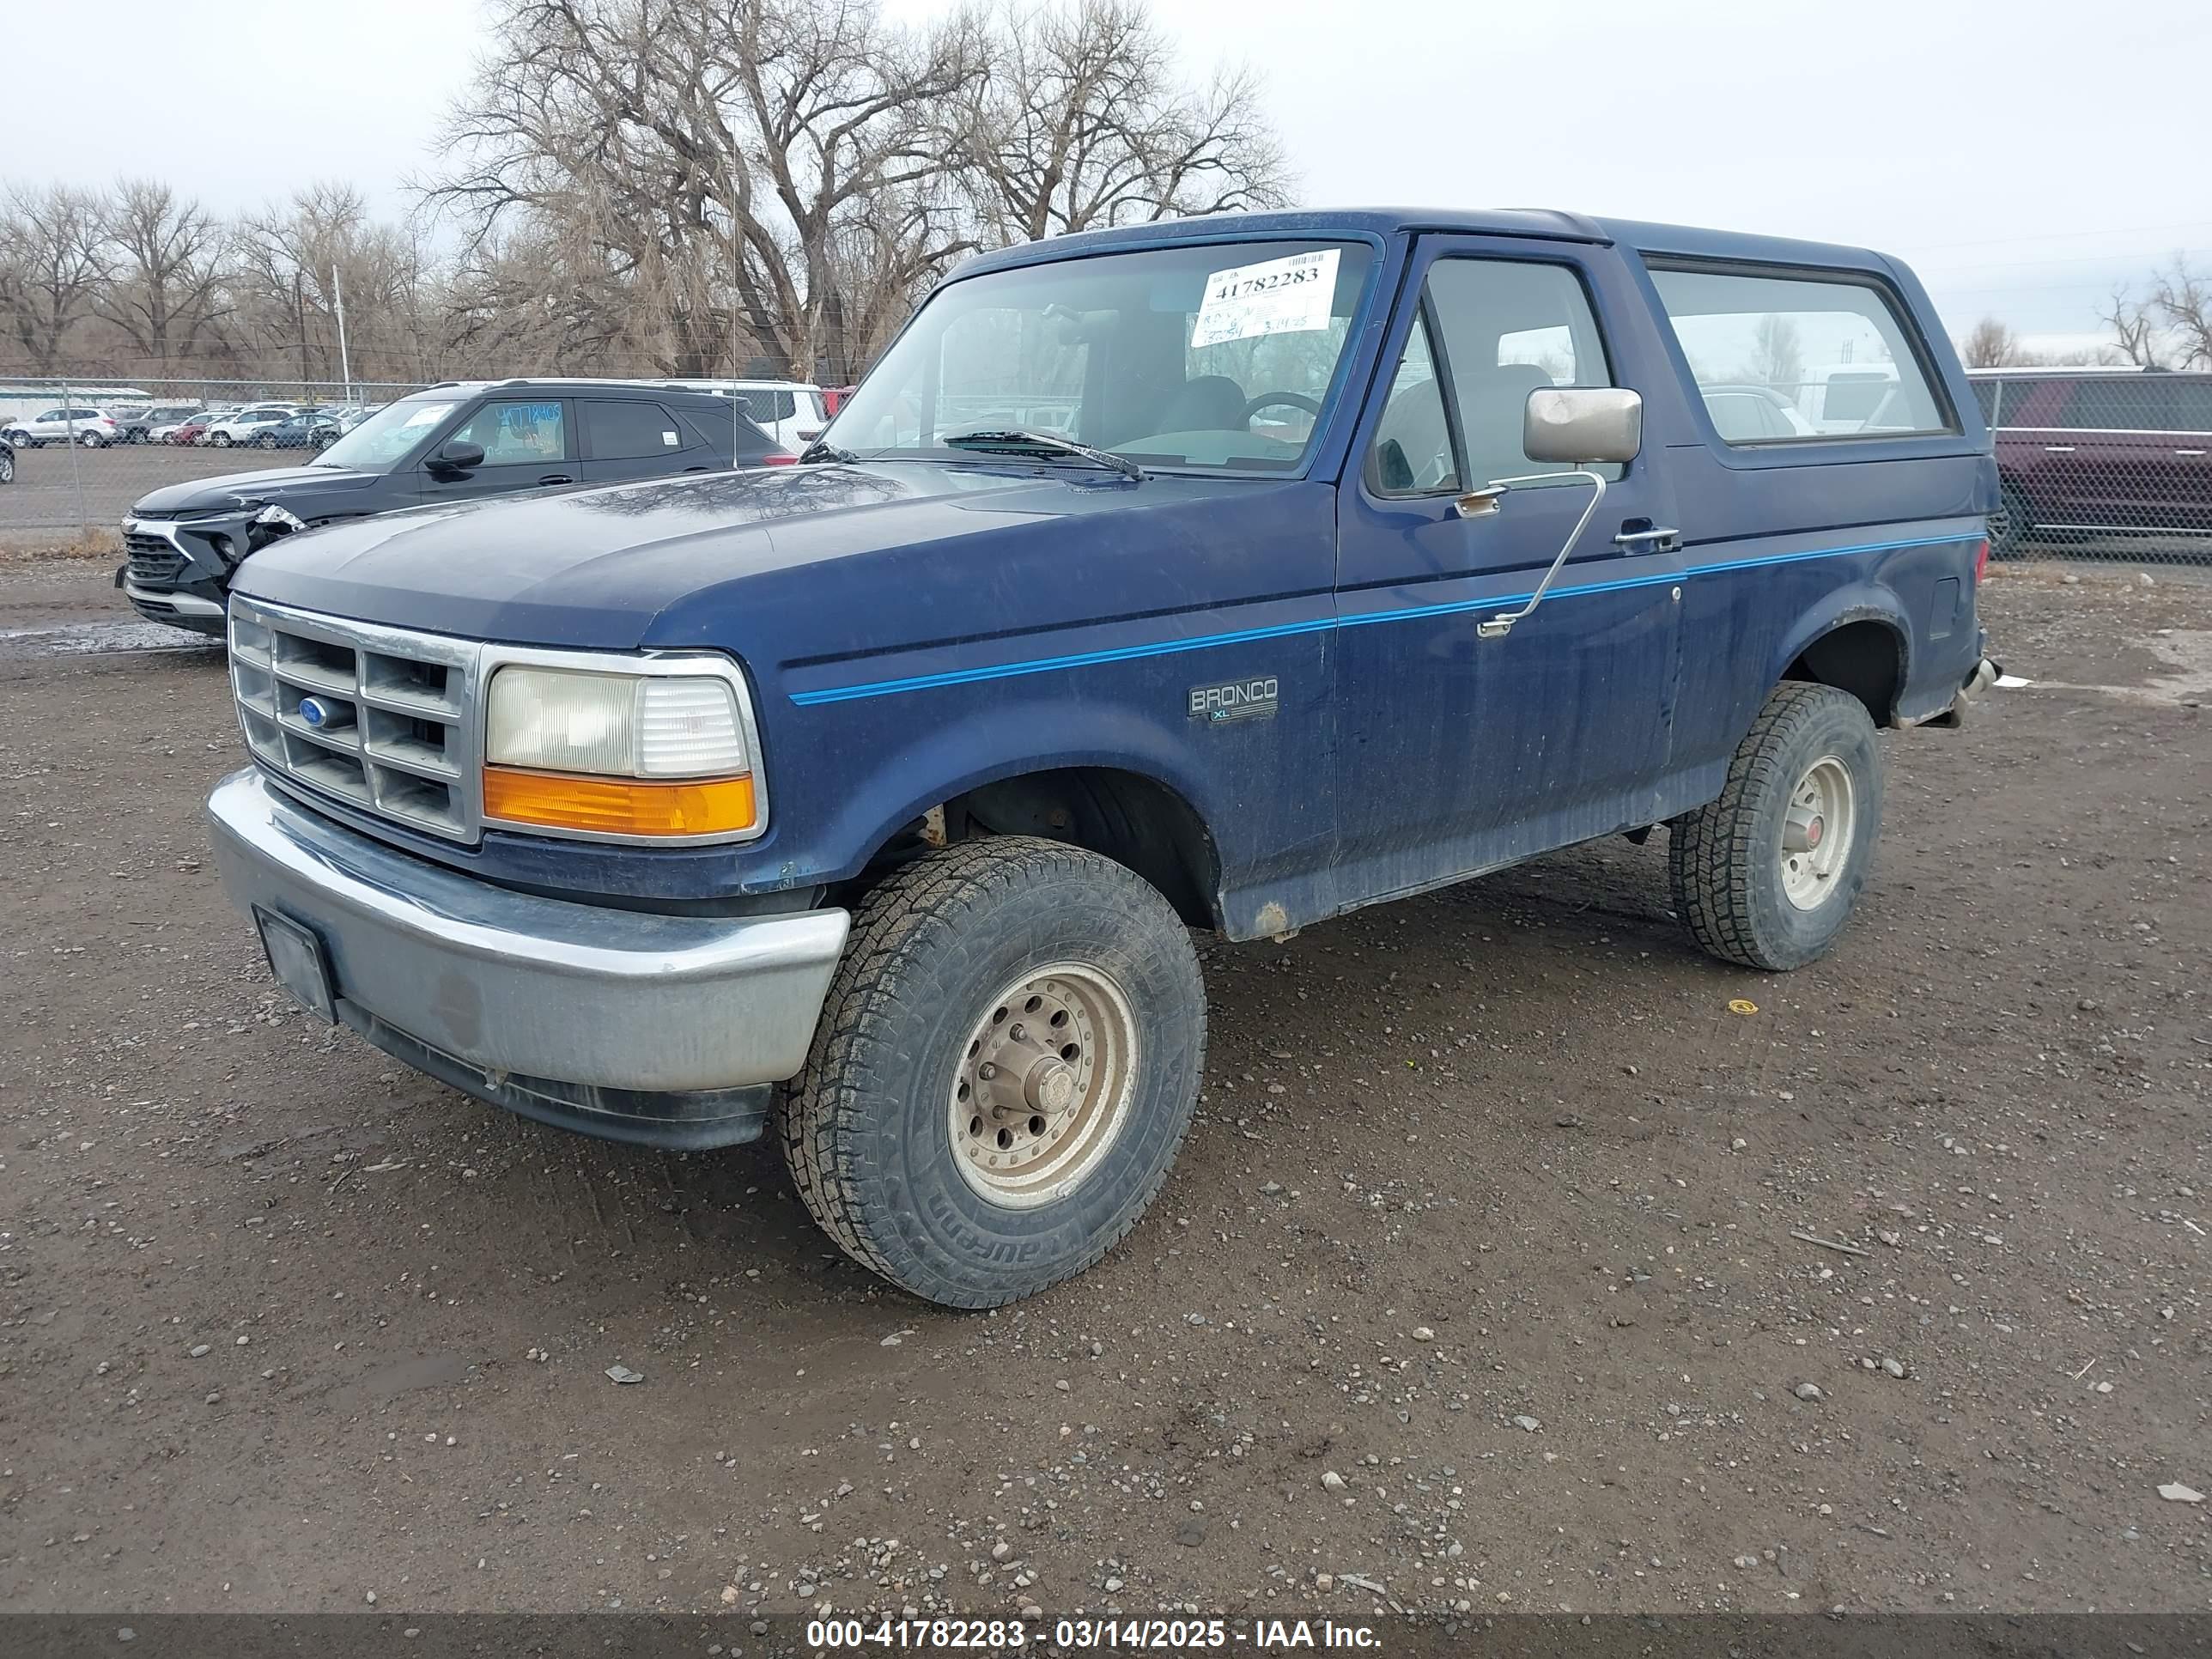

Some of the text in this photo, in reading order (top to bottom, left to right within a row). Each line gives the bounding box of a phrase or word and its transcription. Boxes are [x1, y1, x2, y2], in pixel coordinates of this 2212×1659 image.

[1216, 267, 1319, 299] 41782283
[1191, 678, 1278, 711] BRONCO
[1213, 709, 1231, 720] XL
